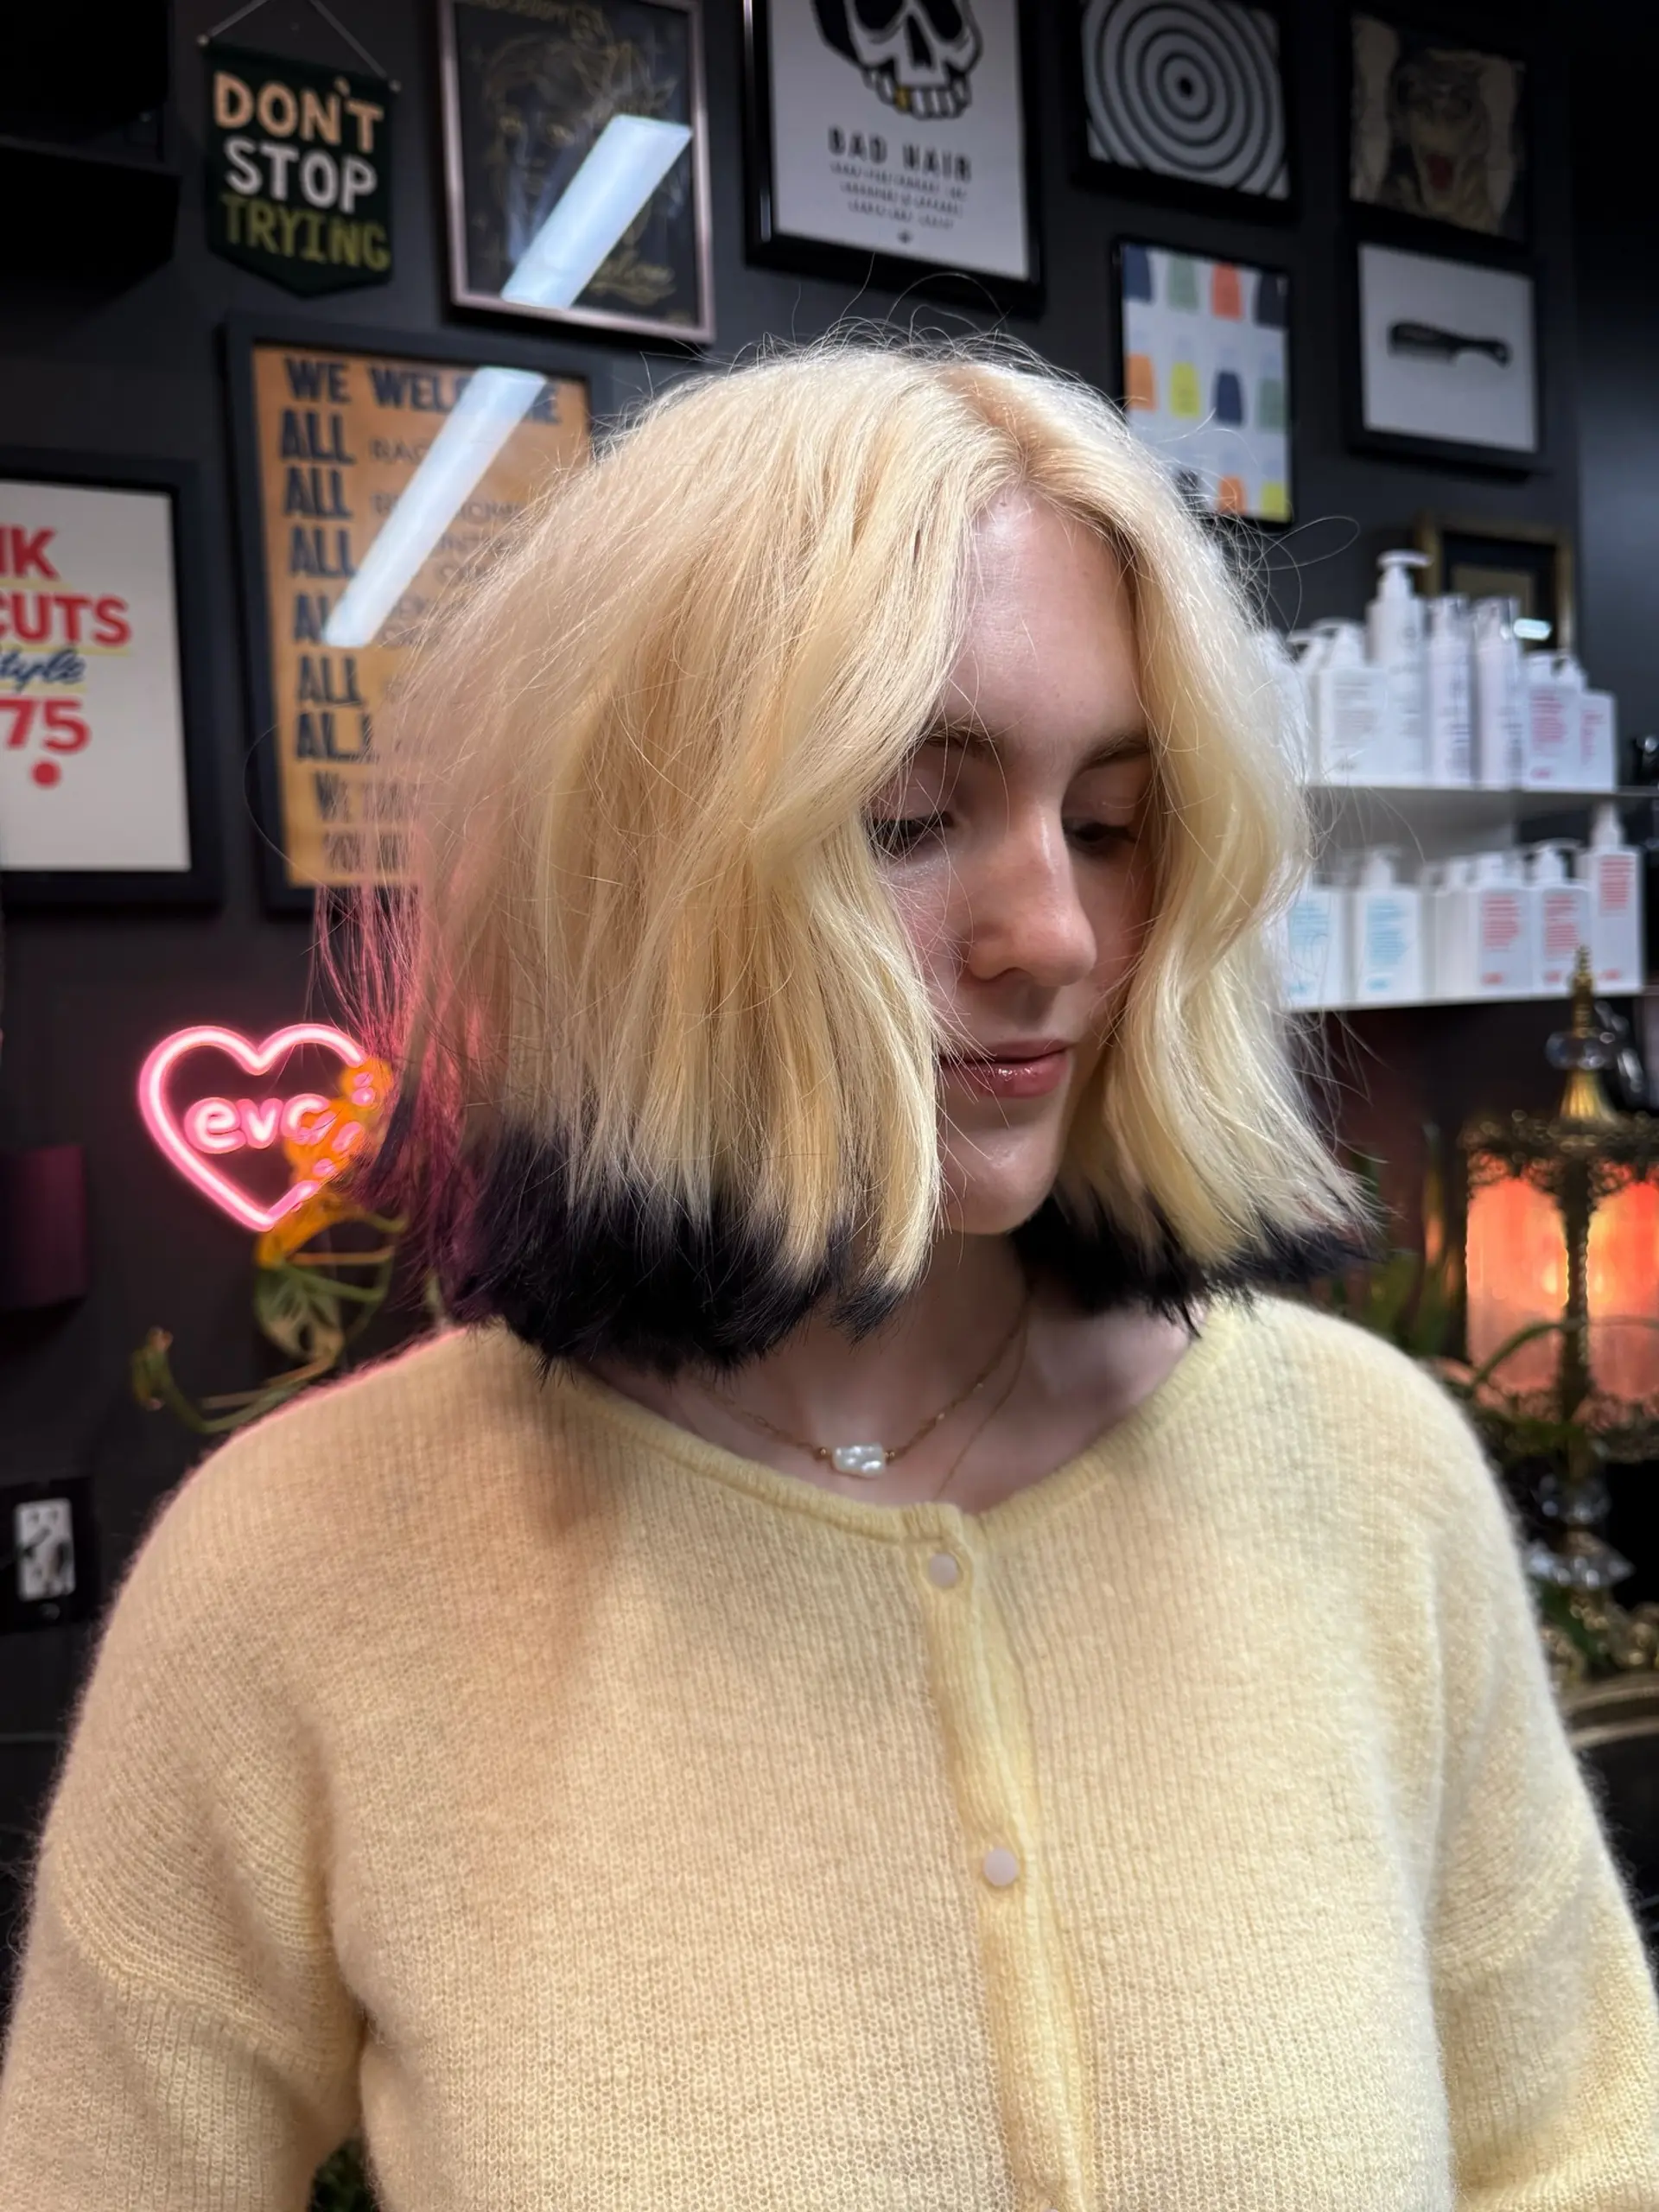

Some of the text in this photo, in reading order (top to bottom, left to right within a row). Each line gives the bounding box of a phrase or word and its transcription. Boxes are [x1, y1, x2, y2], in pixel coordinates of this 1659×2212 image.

[213, 71, 384, 153] DON'T
[224, 136, 378, 213] STOP
[828, 125, 888, 164] BAD
[902, 142, 972, 184] HAIR
[221, 193, 391, 271] TRYING
[284, 356, 351, 404] WE
[281, 409, 356, 464] ALL
[284, 466, 353, 517] ALL
[290, 524, 358, 578] ALL
[294, 594, 328, 645] AL
[298, 654, 365, 704] ALL
[0, 696, 92, 753] 75
